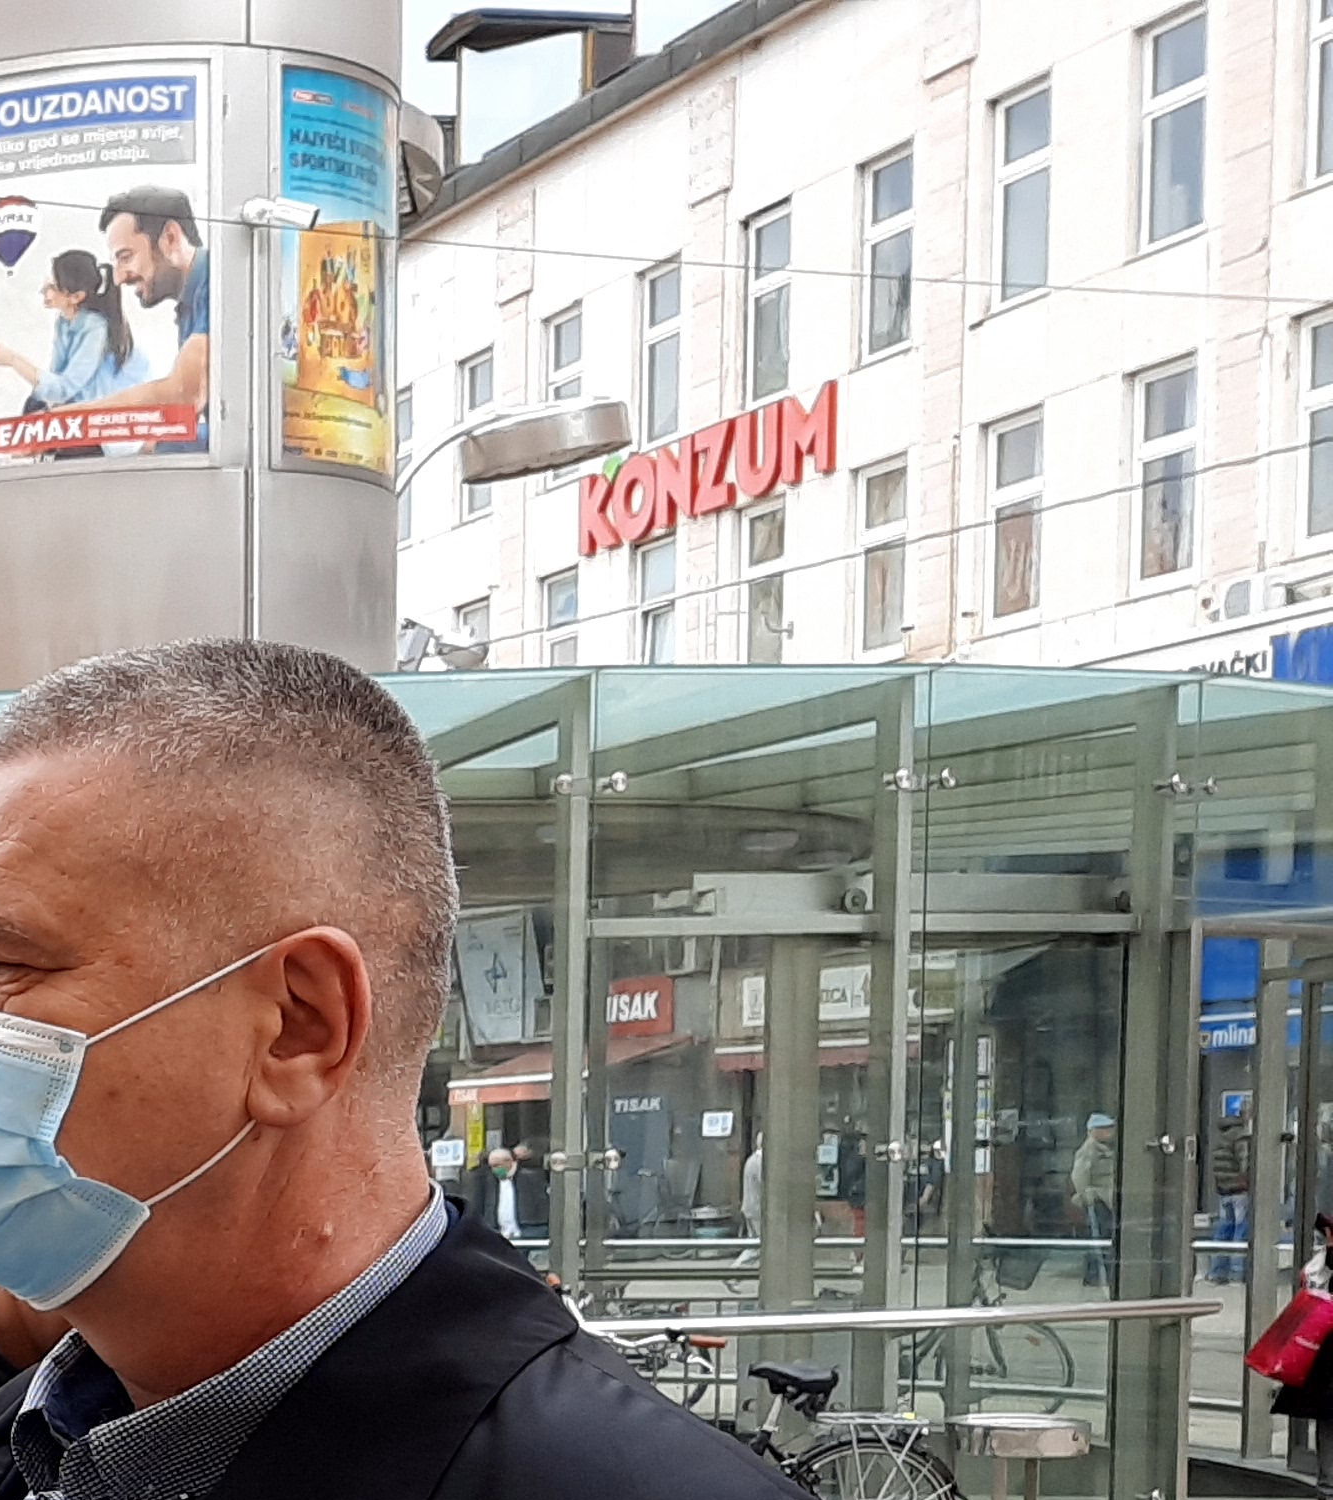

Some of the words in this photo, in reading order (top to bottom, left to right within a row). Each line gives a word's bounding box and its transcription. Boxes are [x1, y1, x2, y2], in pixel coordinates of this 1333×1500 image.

[27, 133, 58, 152] god
[61, 133, 80, 147] se
[83, 126, 137, 145] mijenja
[19, 149, 96, 172] vrijednosti
[579, 380, 838, 557] KONZUM
[614, 1096, 662, 1114] TISAK
